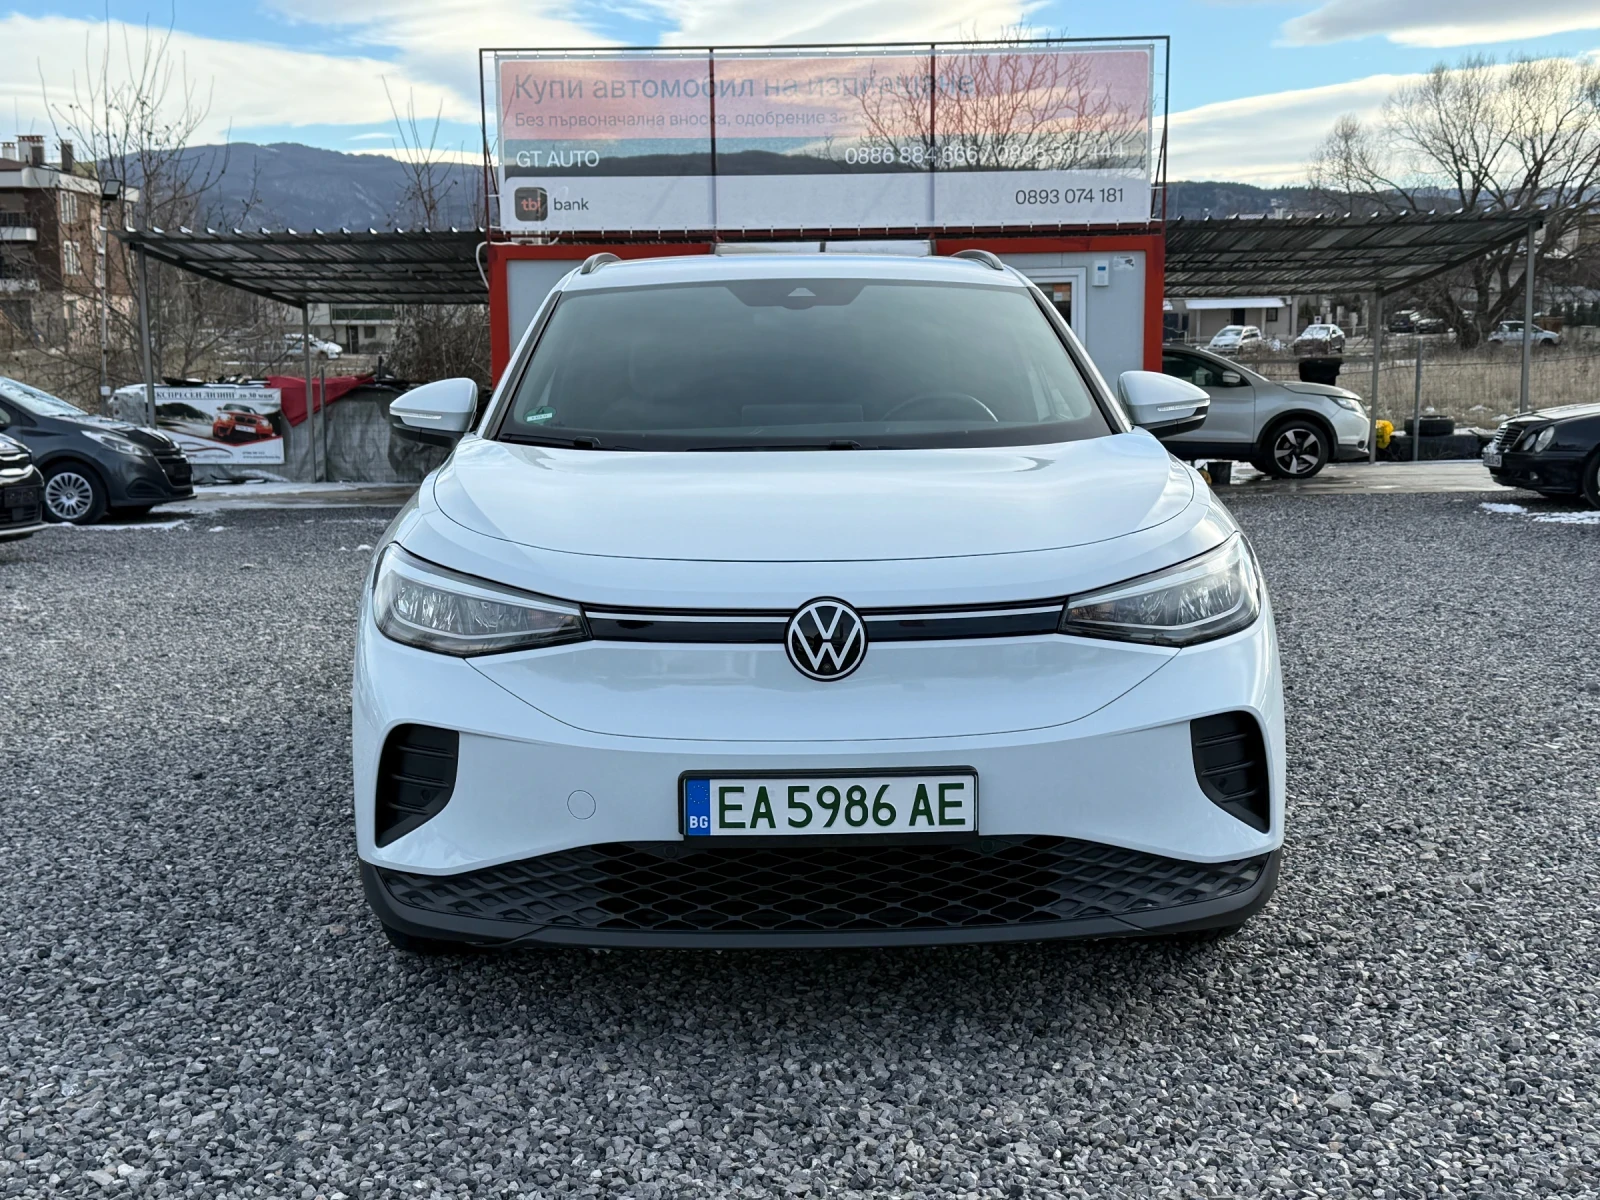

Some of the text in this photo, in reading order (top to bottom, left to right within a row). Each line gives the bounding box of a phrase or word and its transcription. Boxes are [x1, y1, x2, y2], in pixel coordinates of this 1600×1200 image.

[515, 74, 583, 105] Купи
[593, 76, 754, 99] автомобил
[764, 78, 798, 97] на
[515, 112, 544, 127] Без
[549, 114, 665, 129] първоначална
[670, 113, 731, 127] вноса,
[735, 111, 825, 127] одобрение
[516, 150, 599, 167] GT AUTO
[845, 147, 894, 164] 0886
[900, 146, 936, 163] 884
[553, 198, 589, 210] bank
[1015, 187, 1123, 204] 0893 074 181
[718, 782, 966, 829] EA 5986 AE
[689, 816, 708, 829] BG
